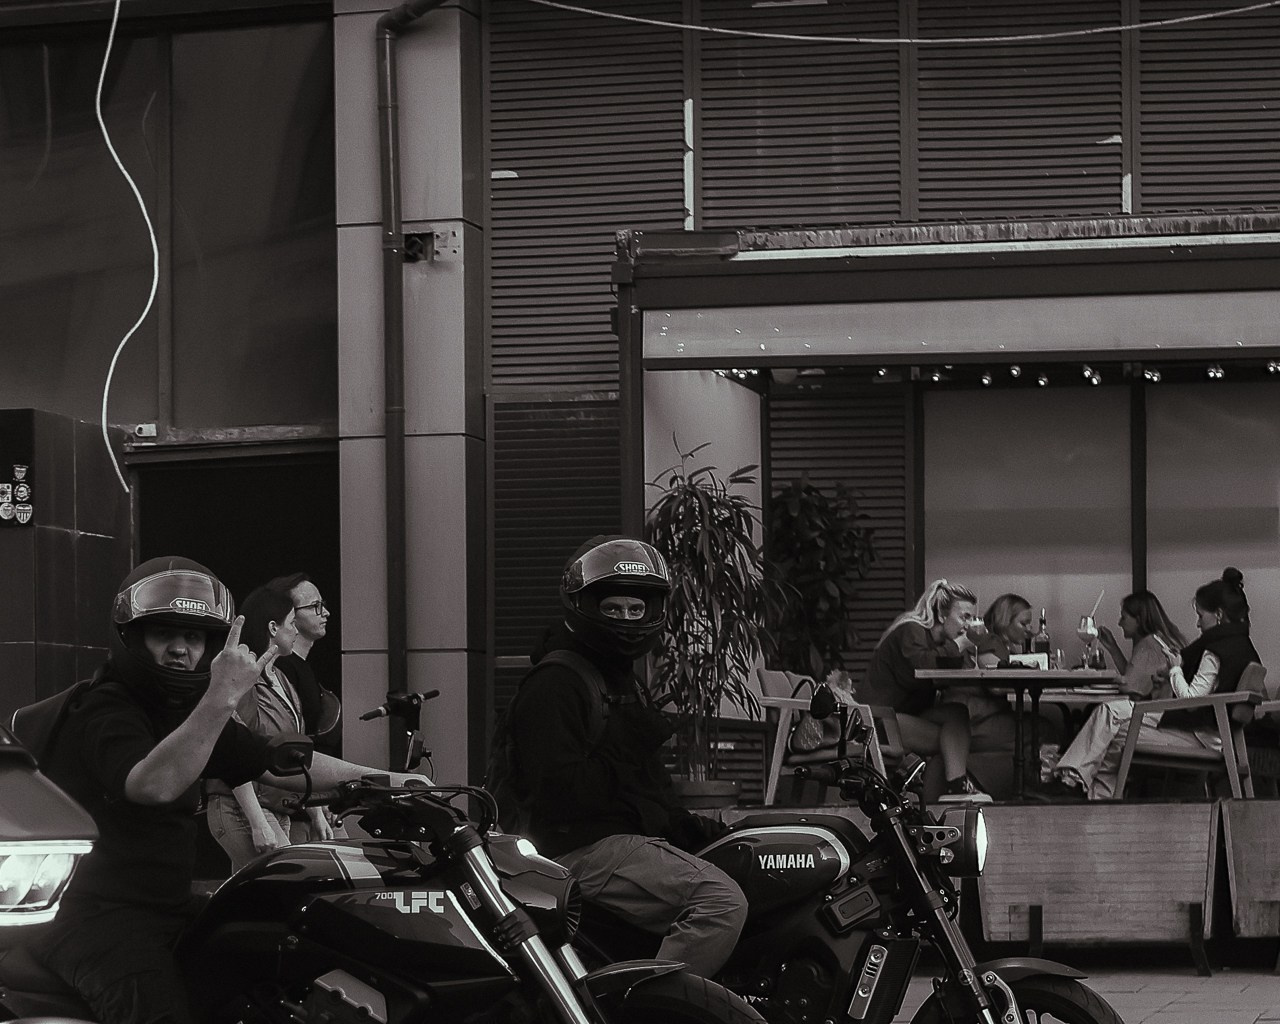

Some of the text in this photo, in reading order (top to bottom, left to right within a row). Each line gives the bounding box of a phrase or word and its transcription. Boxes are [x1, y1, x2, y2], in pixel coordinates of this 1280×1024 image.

[758, 854, 815, 869] YAMAHA
[375, 891, 444, 913] 700 LFC
